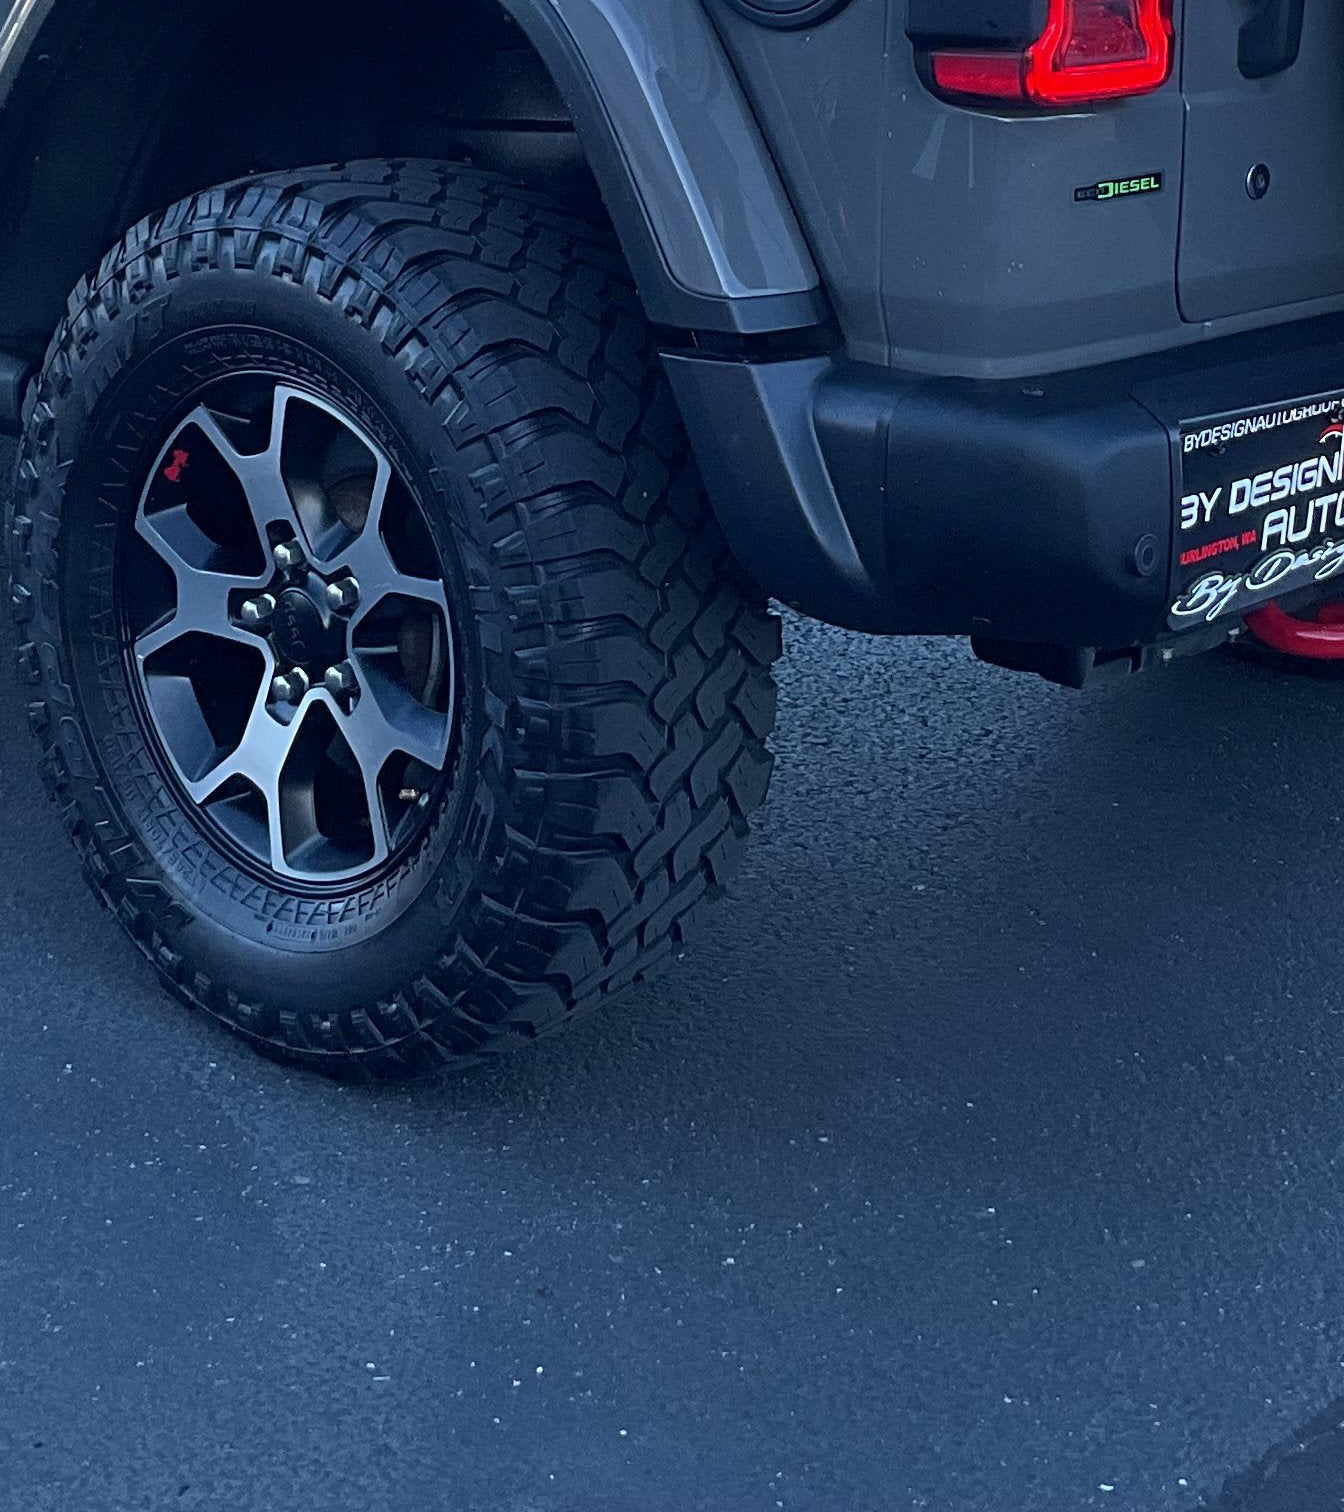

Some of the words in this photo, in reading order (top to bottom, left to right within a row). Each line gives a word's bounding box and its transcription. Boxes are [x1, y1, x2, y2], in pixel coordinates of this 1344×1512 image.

[1180, 487, 1222, 530] BY
[1228, 451, 1344, 515] DESIGN
[1171, 574, 1243, 621] By
